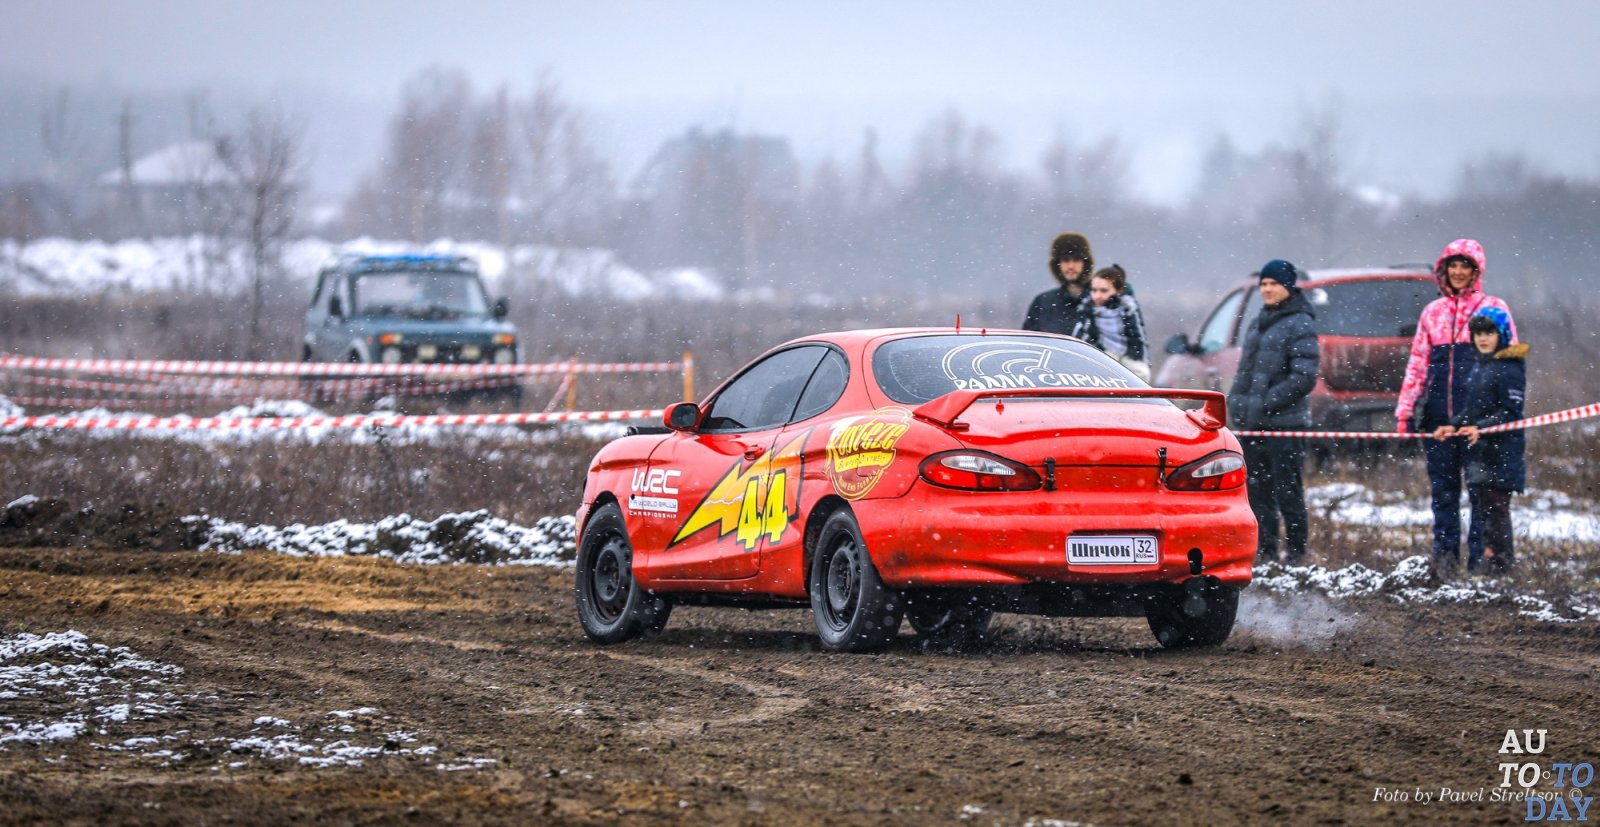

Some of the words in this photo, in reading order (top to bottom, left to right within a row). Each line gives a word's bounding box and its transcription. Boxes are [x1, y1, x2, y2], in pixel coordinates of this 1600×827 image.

[631, 467, 681, 494] WRC
[737, 469, 788, 551] 44
[1072, 543, 1131, 558] Шичок
[1137, 540, 1152, 553] 32
